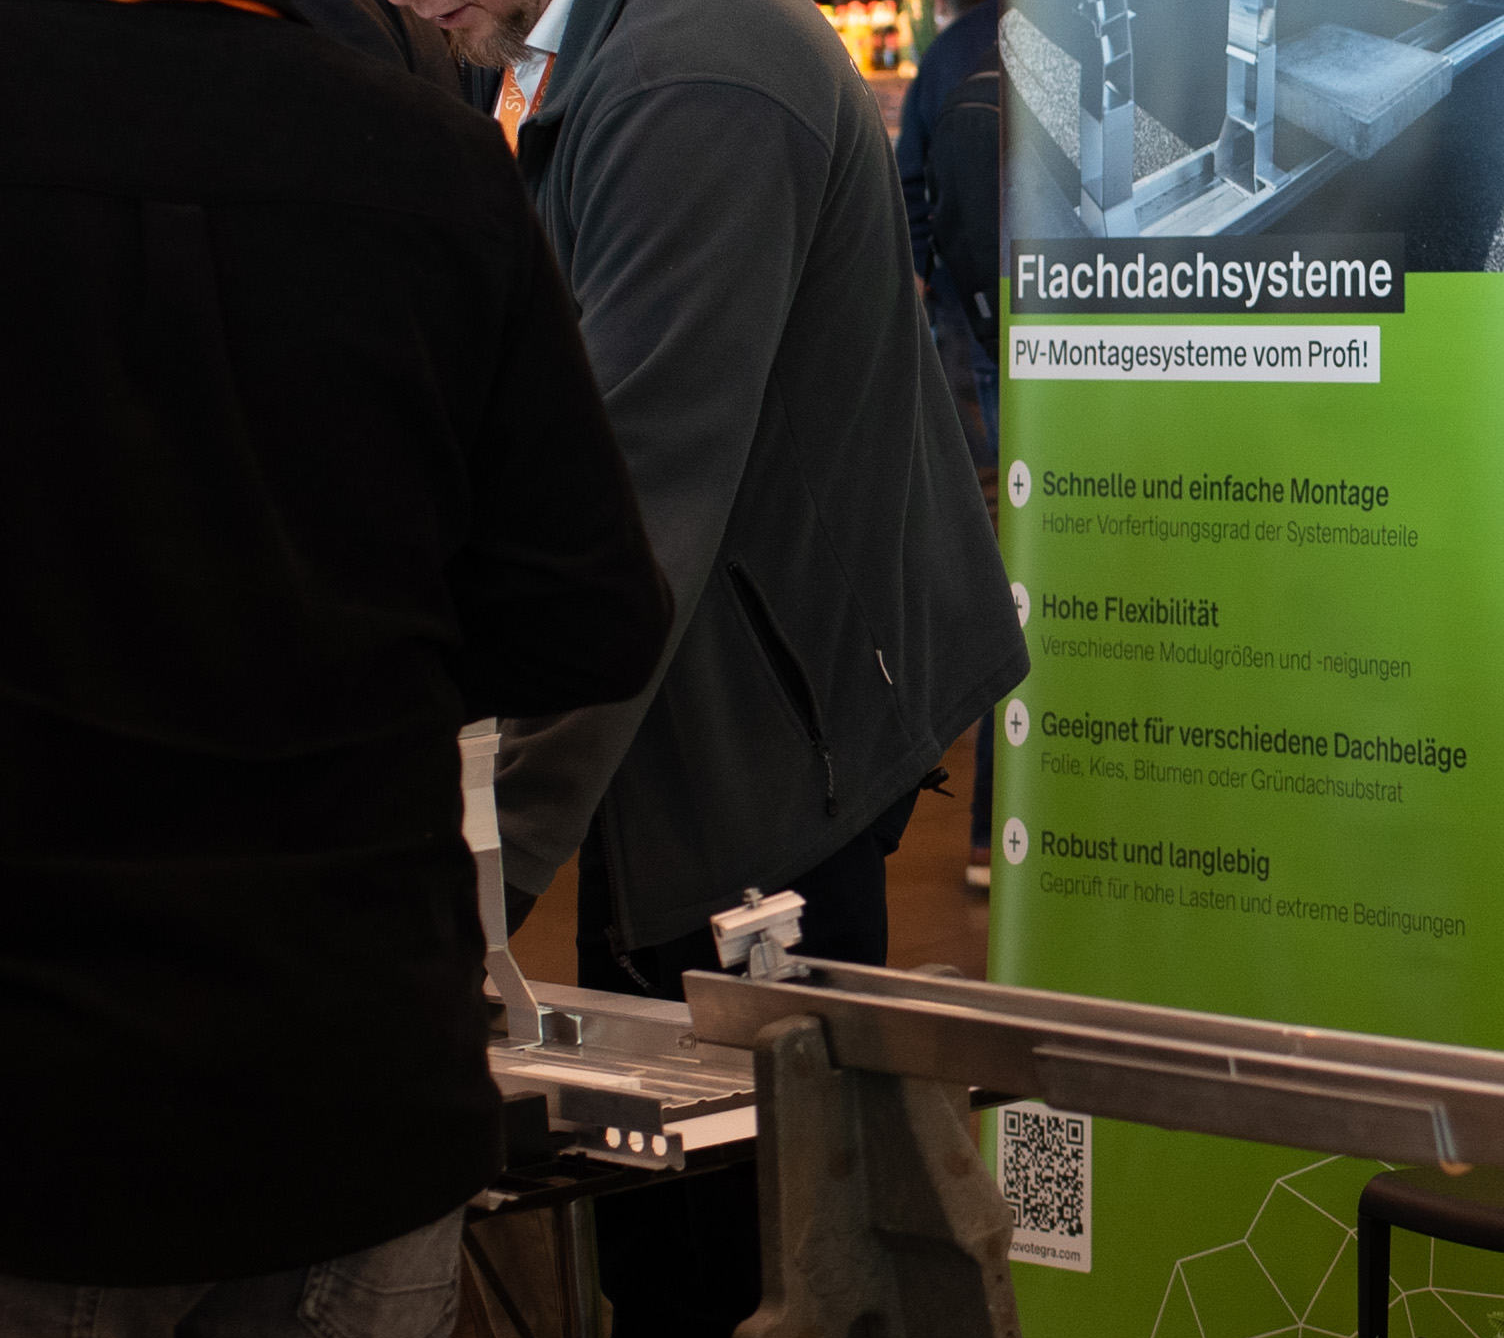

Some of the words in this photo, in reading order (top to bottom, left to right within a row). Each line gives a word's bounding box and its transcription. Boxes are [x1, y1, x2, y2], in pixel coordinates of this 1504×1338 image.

[1017, 251, 1392, 308] Flachdachsysteme
[1015, 339, 1247, 371] PV-Montagesysteme
[1254, 343, 1302, 367] vom
[1308, 341, 1368, 368] Profi!
[1043, 472, 1136, 499] Schnelle
[1143, 474, 1183, 500] und
[1189, 475, 1284, 503] einfache
[1290, 479, 1389, 511] Montage
[1042, 513, 1092, 534] Hoher
[1097, 514, 1250, 543] Vorfertigungsgrad
[1255, 521, 1281, 542] der
[1287, 521, 1418, 548] Systembauteile
[1042, 594, 1098, 620] Hohe
[1104, 597, 1219, 627] Flexibilität
[1041, 636, 1154, 661] Verschiedene
[1160, 642, 1274, 670] Modulgrößen
[1280, 648, 1311, 670] und
[1317, 652, 1411, 680] -neigungen
[1041, 712, 1139, 744] Geeignet
[1144, 717, 1175, 746] für
[1179, 722, 1327, 756] verschiedene
[1334, 733, 1467, 772] Dachbeläge
[1041, 752, 1085, 778] Folie,
[1090, 756, 1128, 780] Kies,
[1134, 759, 1203, 787] Bitumen
[1209, 766, 1247, 790] oder
[1252, 769, 1403, 803] Gründachsubstrat
[1041, 831, 1117, 862] Robust
[1123, 838, 1163, 864] und
[1169, 843, 1270, 881] langlebig
[1040, 872, 1103, 899] Geprüft
[1108, 878, 1129, 899] für
[1134, 882, 1175, 905] hohe
[1180, 886, 1235, 910] Lasten
[1241, 893, 1271, 915] und
[1276, 897, 1349, 923] extreme
[1354, 903, 1465, 938] Bedingungen
[1011, 1242, 1081, 1261] ovotegra.com
